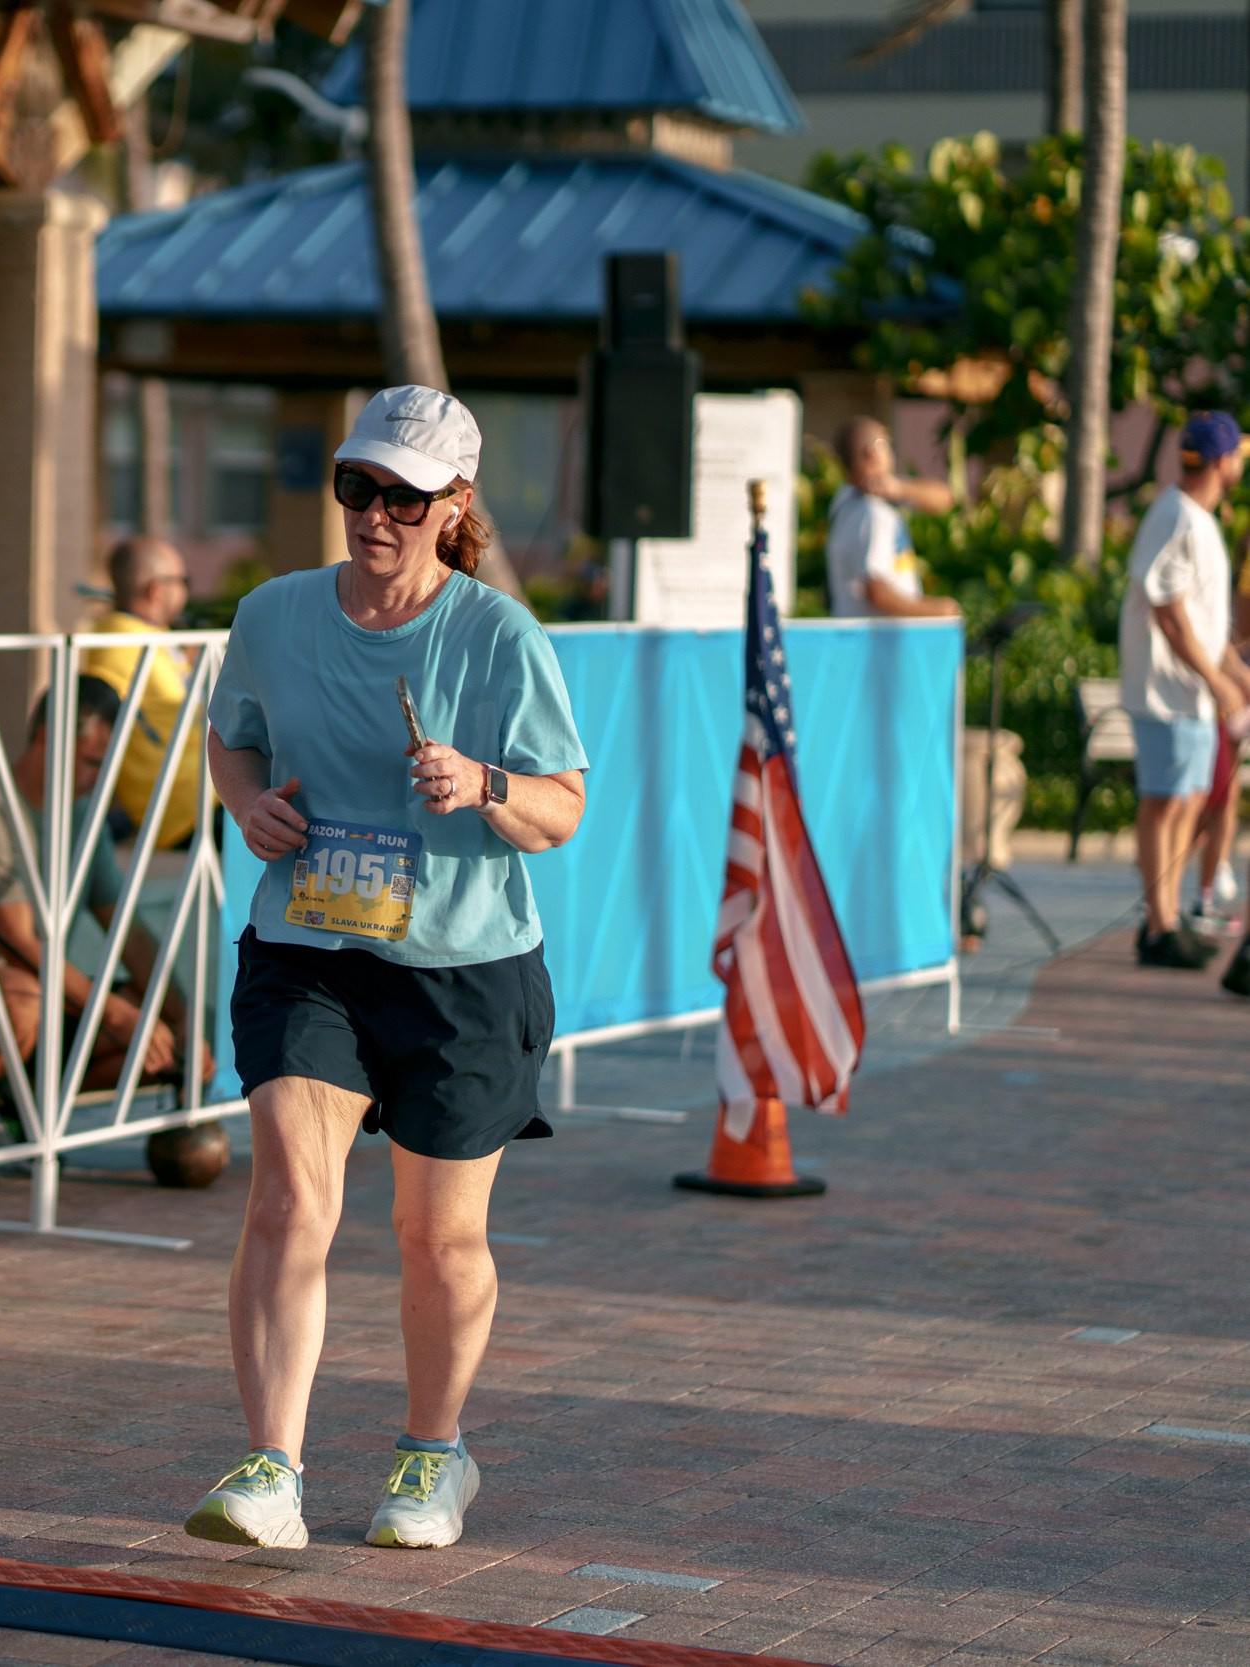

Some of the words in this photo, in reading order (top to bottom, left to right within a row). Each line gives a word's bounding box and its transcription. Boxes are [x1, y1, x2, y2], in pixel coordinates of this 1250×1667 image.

[308, 825, 346, 839] RAZOM
[377, 834, 408, 848] RUN
[398, 857, 412, 867] 5K
[314, 848, 385, 899] 195
[331, 917, 357, 927] SLAVA
